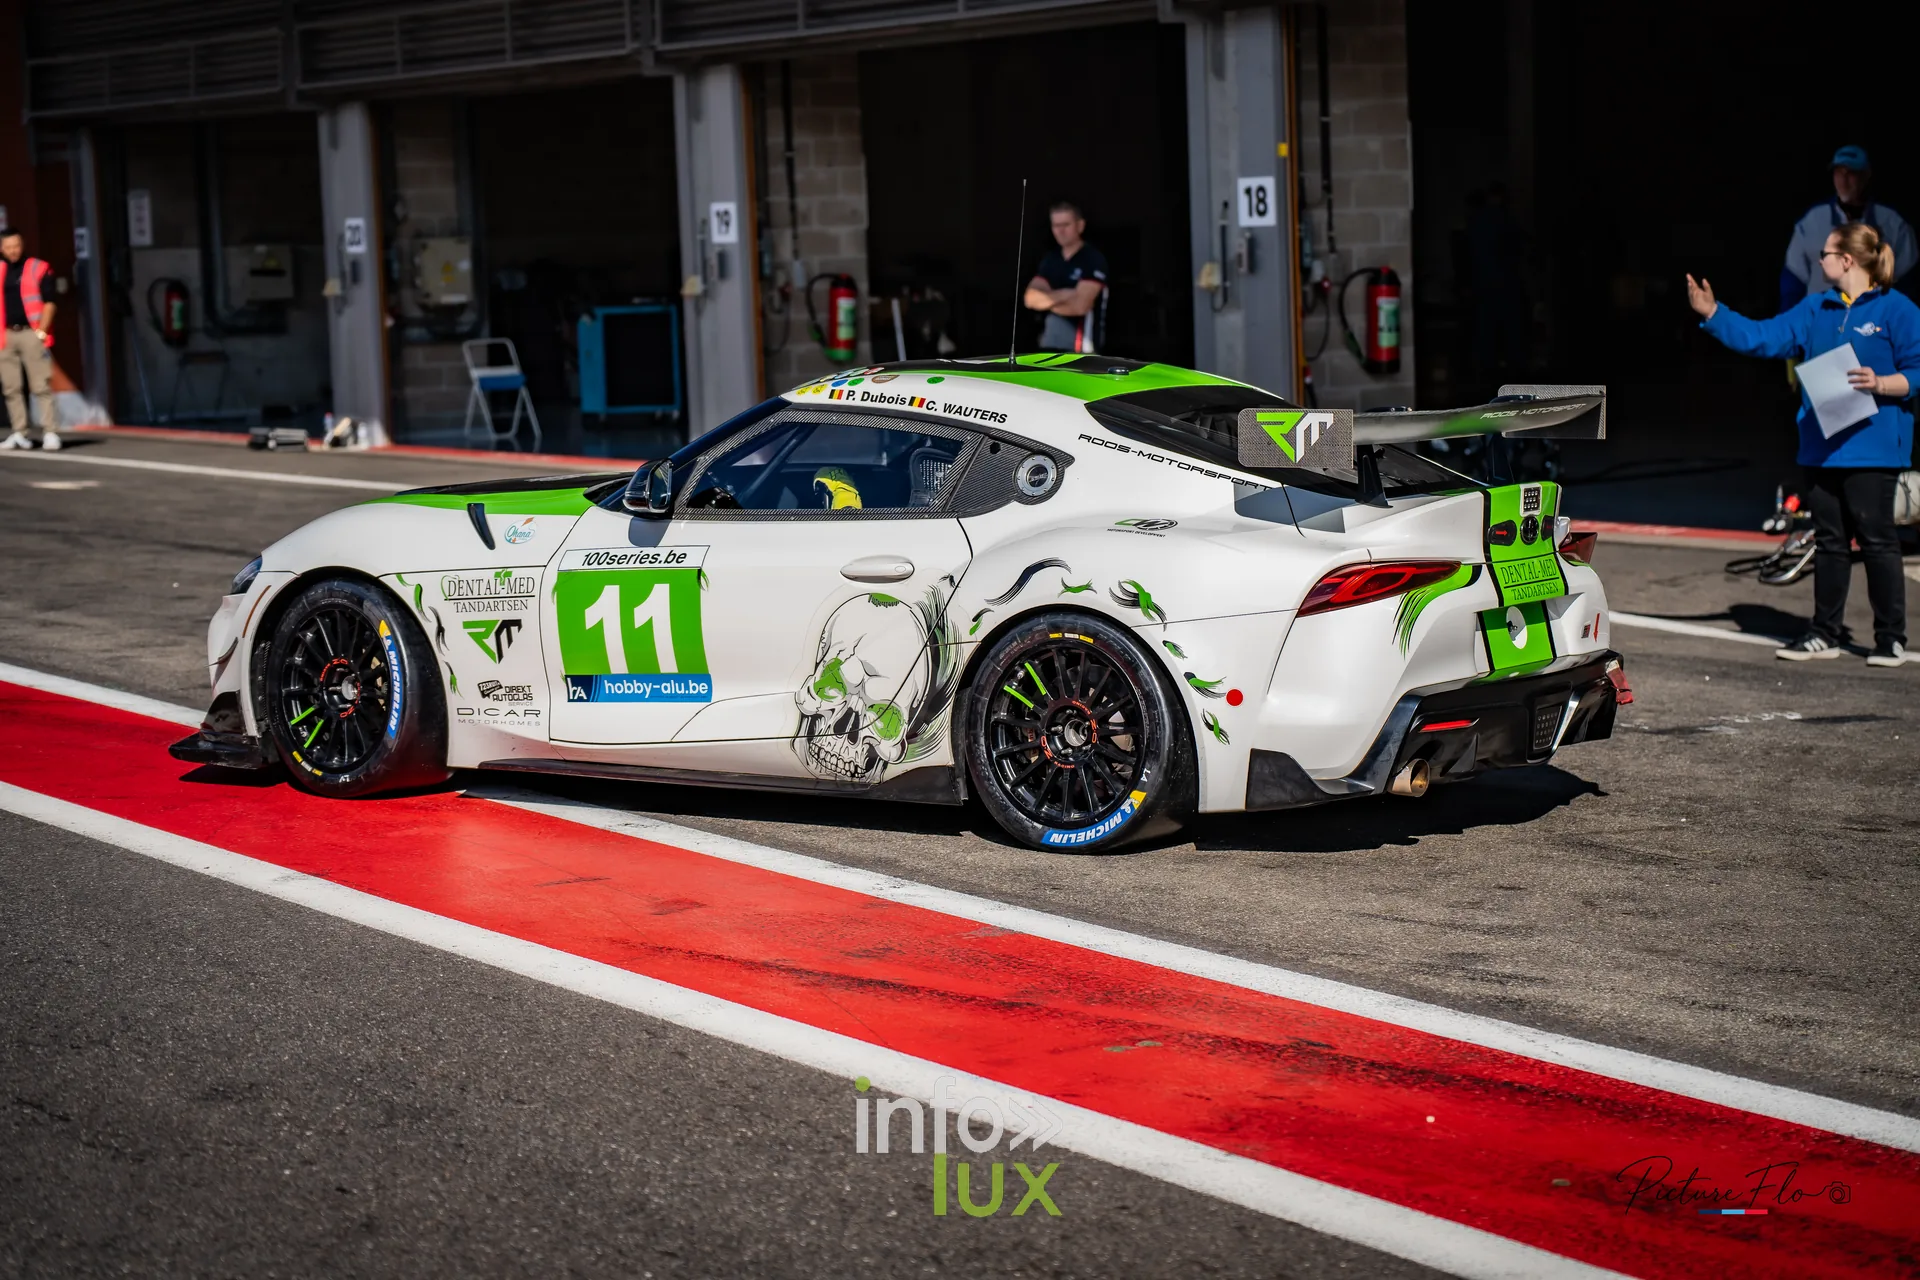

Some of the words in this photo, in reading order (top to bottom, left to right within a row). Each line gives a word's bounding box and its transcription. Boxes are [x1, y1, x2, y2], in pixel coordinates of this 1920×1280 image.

[1244, 185, 1268, 218] 18
[715, 209, 732, 235] 19
[846, 390, 856, 402] P.
[860, 391, 907, 406] Dubois
[925, 400, 938, 412] C.
[942, 403, 1008, 424] WAUTERS
[1480, 410, 1519, 420] ROOS
[1078, 433, 1273, 492] ROOS-MOTORSPORT
[507, 525, 532, 538] Ohana
[582, 549, 688, 566] 100series.be
[1500, 558, 1557, 585] DENTAL-MED
[447, 576, 535, 597] DENTAL-MED
[1511, 582, 1559, 601] TANDARTSEN
[454, 599, 529, 613] TANDARTSEN
[584, 583, 679, 674] 11
[388, 650, 400, 731] MICHELIN
[493, 693, 534, 702] AUTOGLAS
[505, 685, 531, 693] DIREKT
[604, 679, 709, 699] hobby-alu.be
[457, 707, 541, 718] DICAR
[458, 718, 541, 727] MOTORHOMES
[1049, 811, 1123, 844] MICHELIN
